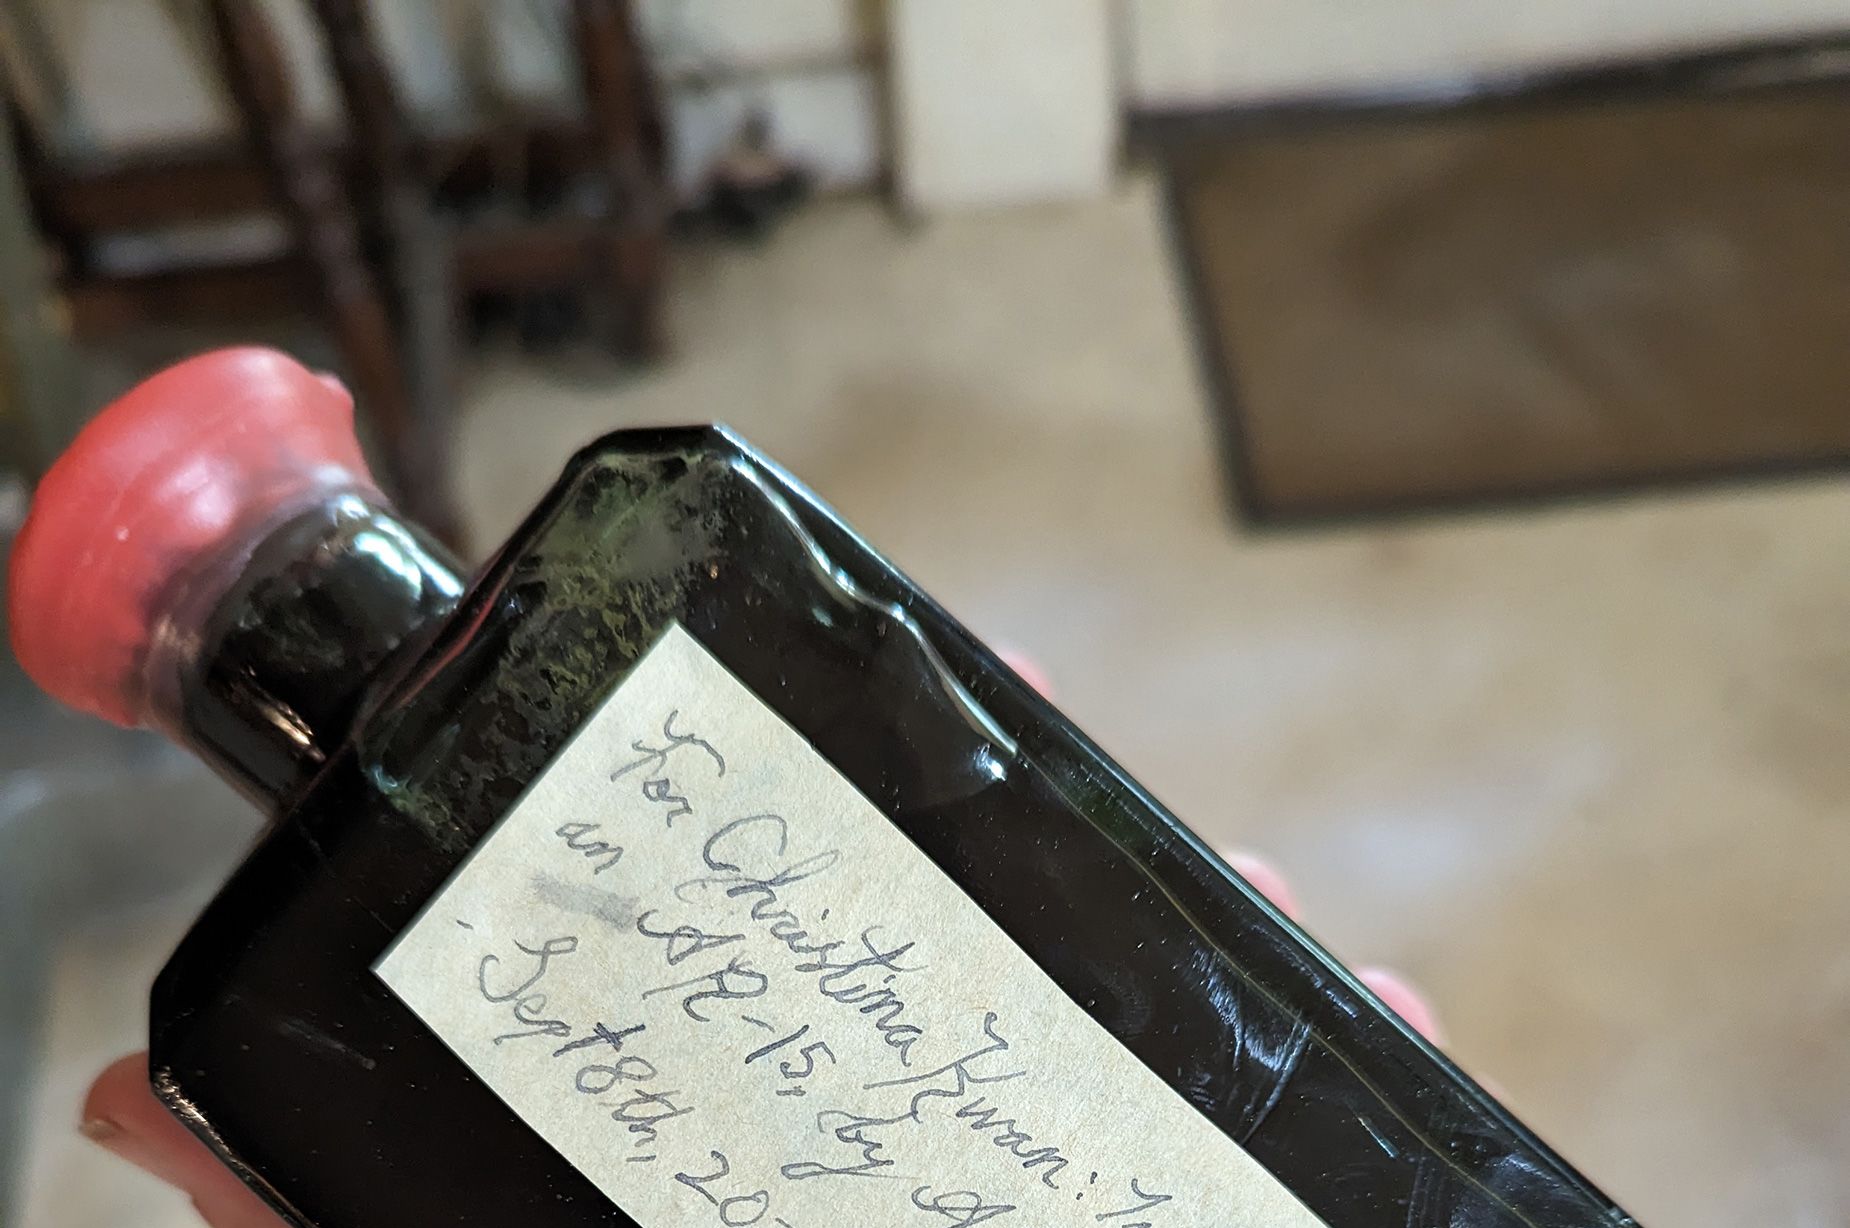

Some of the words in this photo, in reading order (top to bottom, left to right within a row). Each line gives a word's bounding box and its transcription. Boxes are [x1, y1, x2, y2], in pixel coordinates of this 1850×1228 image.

[556, 822, 624, 874] an
[781, 1110, 917, 1180] by
[611, 710, 725, 826] For
[675, 815, 927, 1066] Christina
